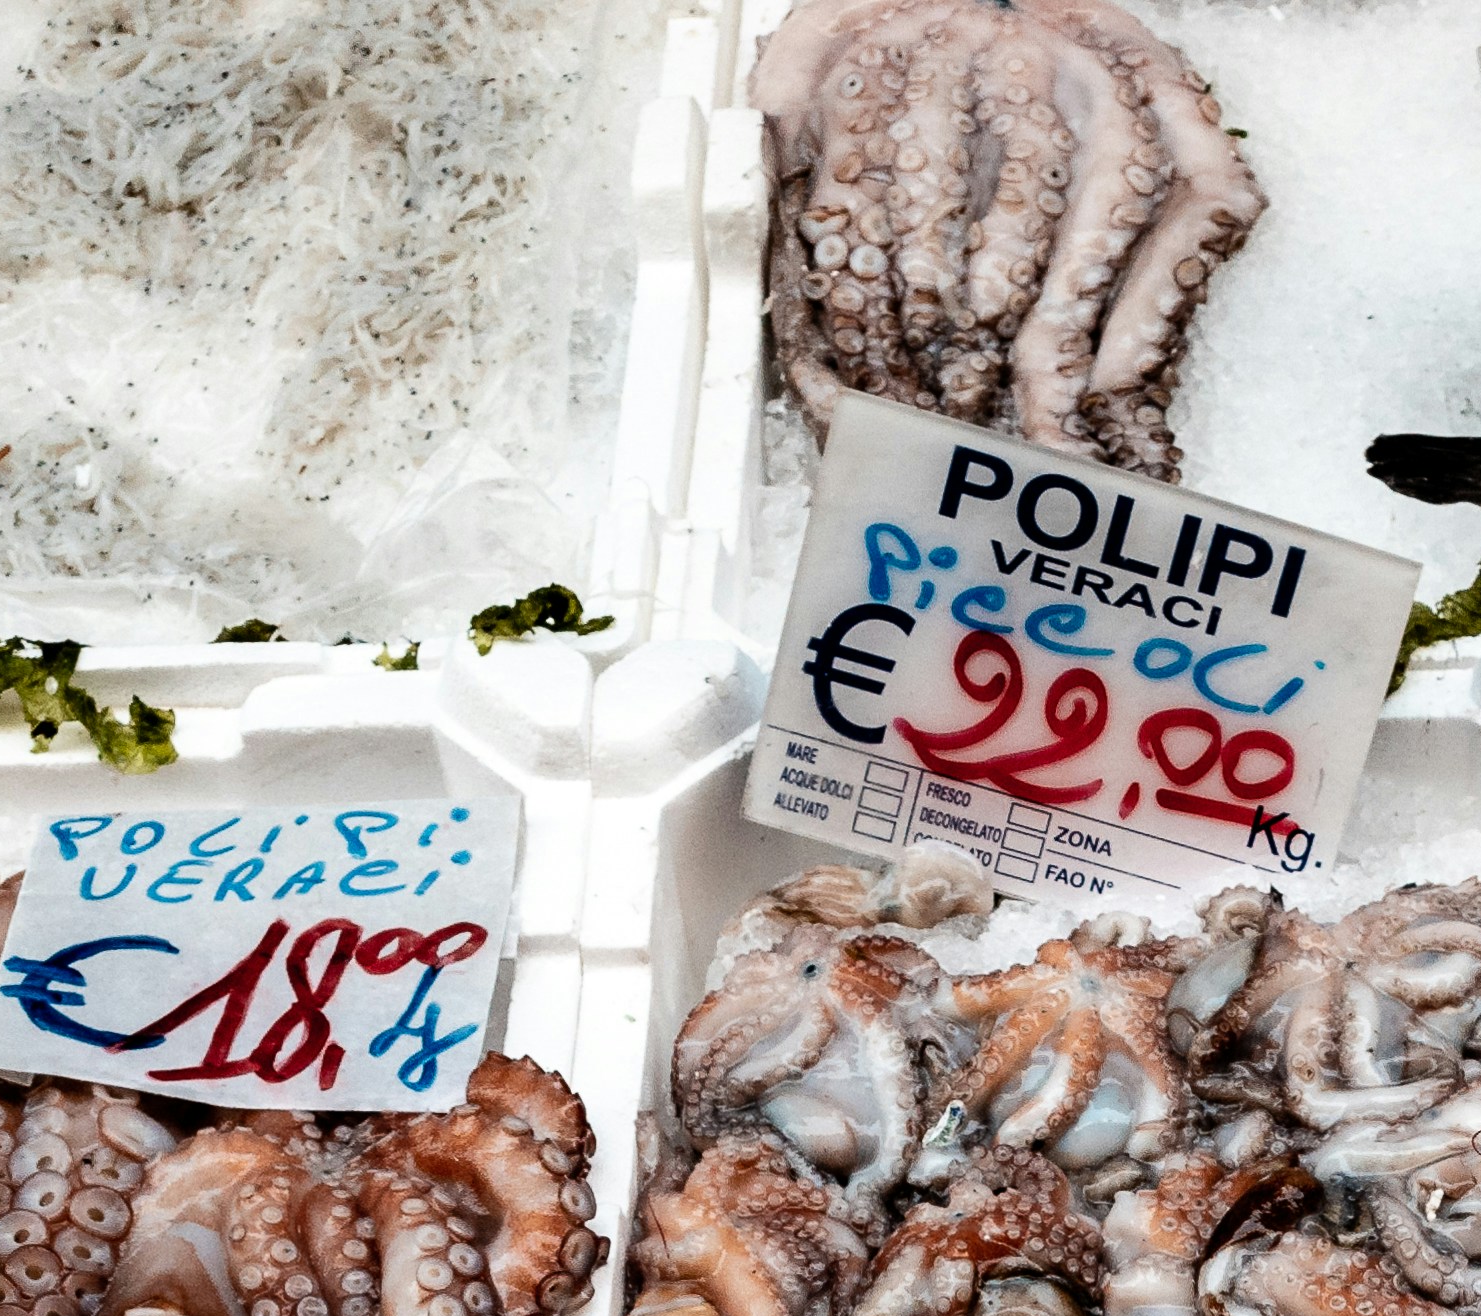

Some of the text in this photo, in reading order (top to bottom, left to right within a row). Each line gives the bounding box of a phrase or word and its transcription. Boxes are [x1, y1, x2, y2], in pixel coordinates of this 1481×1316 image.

[938, 445, 1306, 619] POLIPI
[990, 540, 1222, 636] VERACI
[803, 602, 916, 745] €
[786, 742, 818, 764] MARE
[779, 766, 853, 800] ACQUE DOLCI
[925, 782, 971, 807] FRESCO
[774, 792, 829, 820] ALLEVATO
[920, 808, 1001, 843] DECONGELATO
[1054, 827, 1112, 856] ZONA
[1045, 865, 1114, 894] FAO N°
[0, 934, 180, 1050] €
